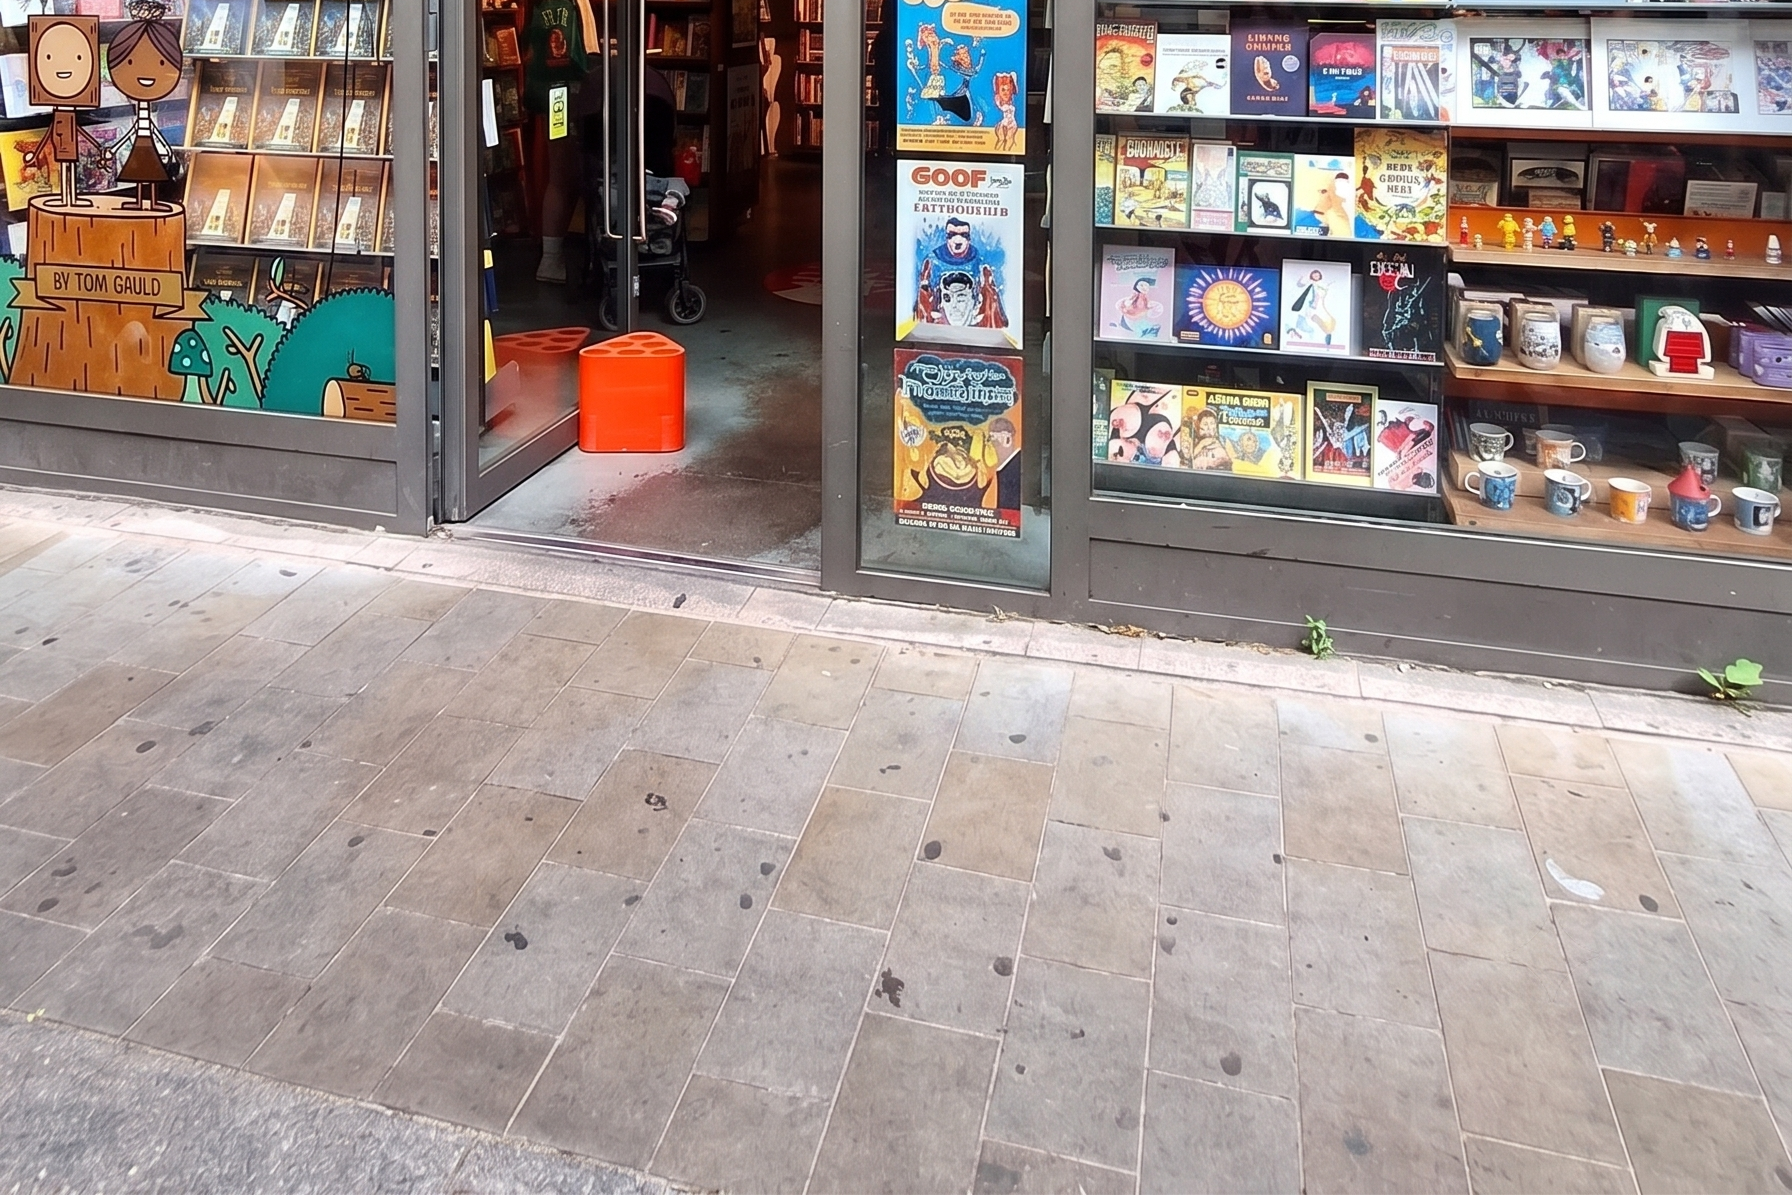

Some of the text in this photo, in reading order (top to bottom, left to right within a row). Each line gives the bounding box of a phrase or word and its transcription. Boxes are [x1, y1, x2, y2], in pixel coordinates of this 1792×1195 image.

[911, 166, 988, 189] GOOF
[53, 271, 162, 297] BY TOM GAULD
